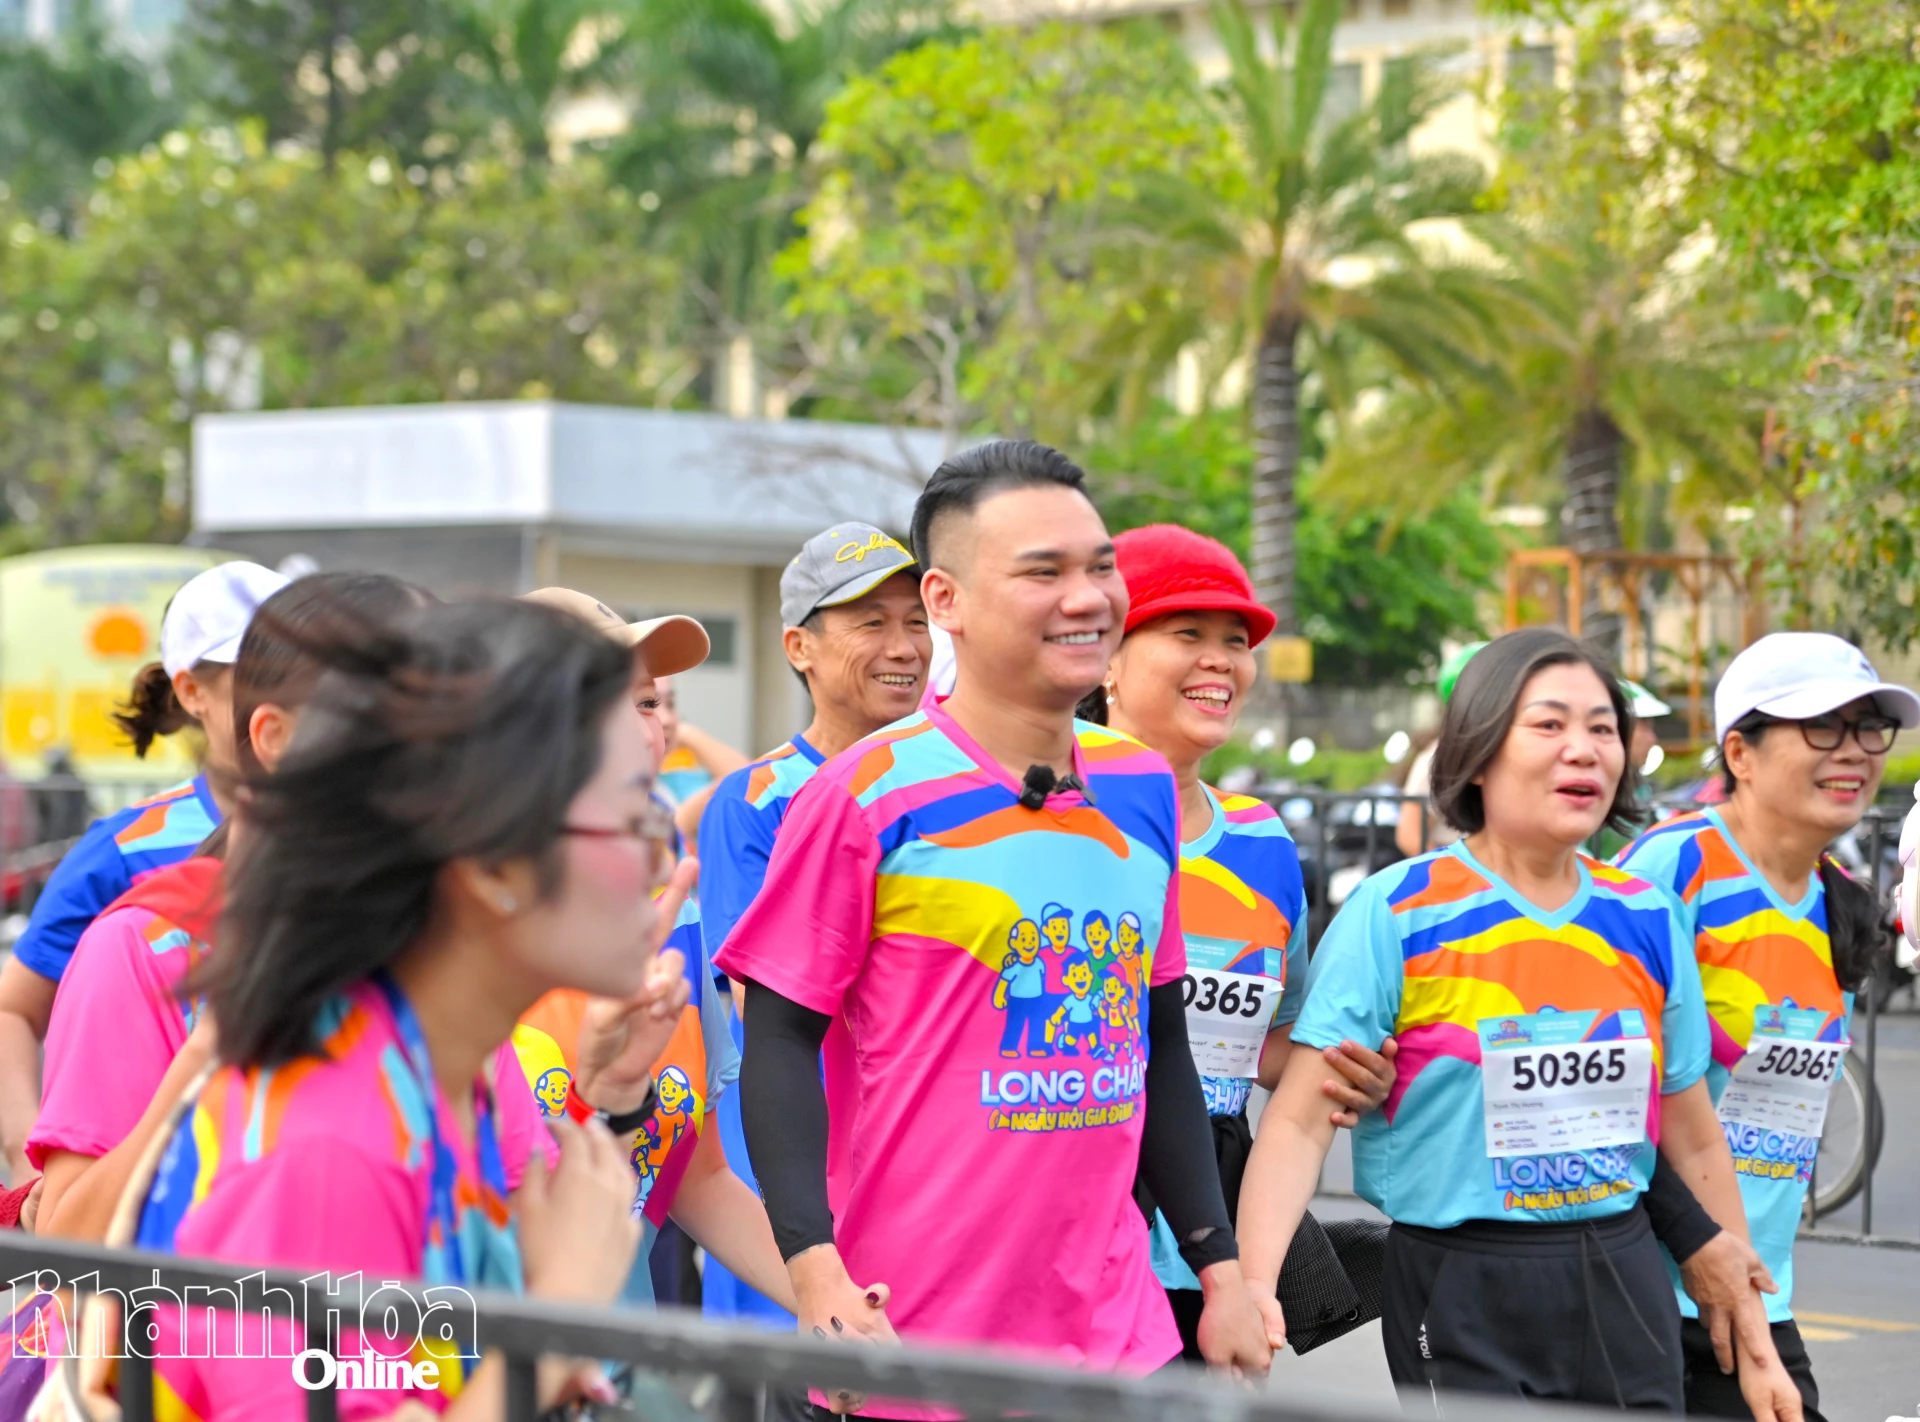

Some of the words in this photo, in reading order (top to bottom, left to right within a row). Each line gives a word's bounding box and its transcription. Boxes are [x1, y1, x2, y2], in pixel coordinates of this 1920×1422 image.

[1513, 1048, 1626, 1091] 50365
[1757, 1045, 1839, 1082] 50365
[980, 1069, 1086, 1106] LONG
[1721, 1122, 1760, 1154] NG
[1494, 1153, 1587, 1190] LONG
